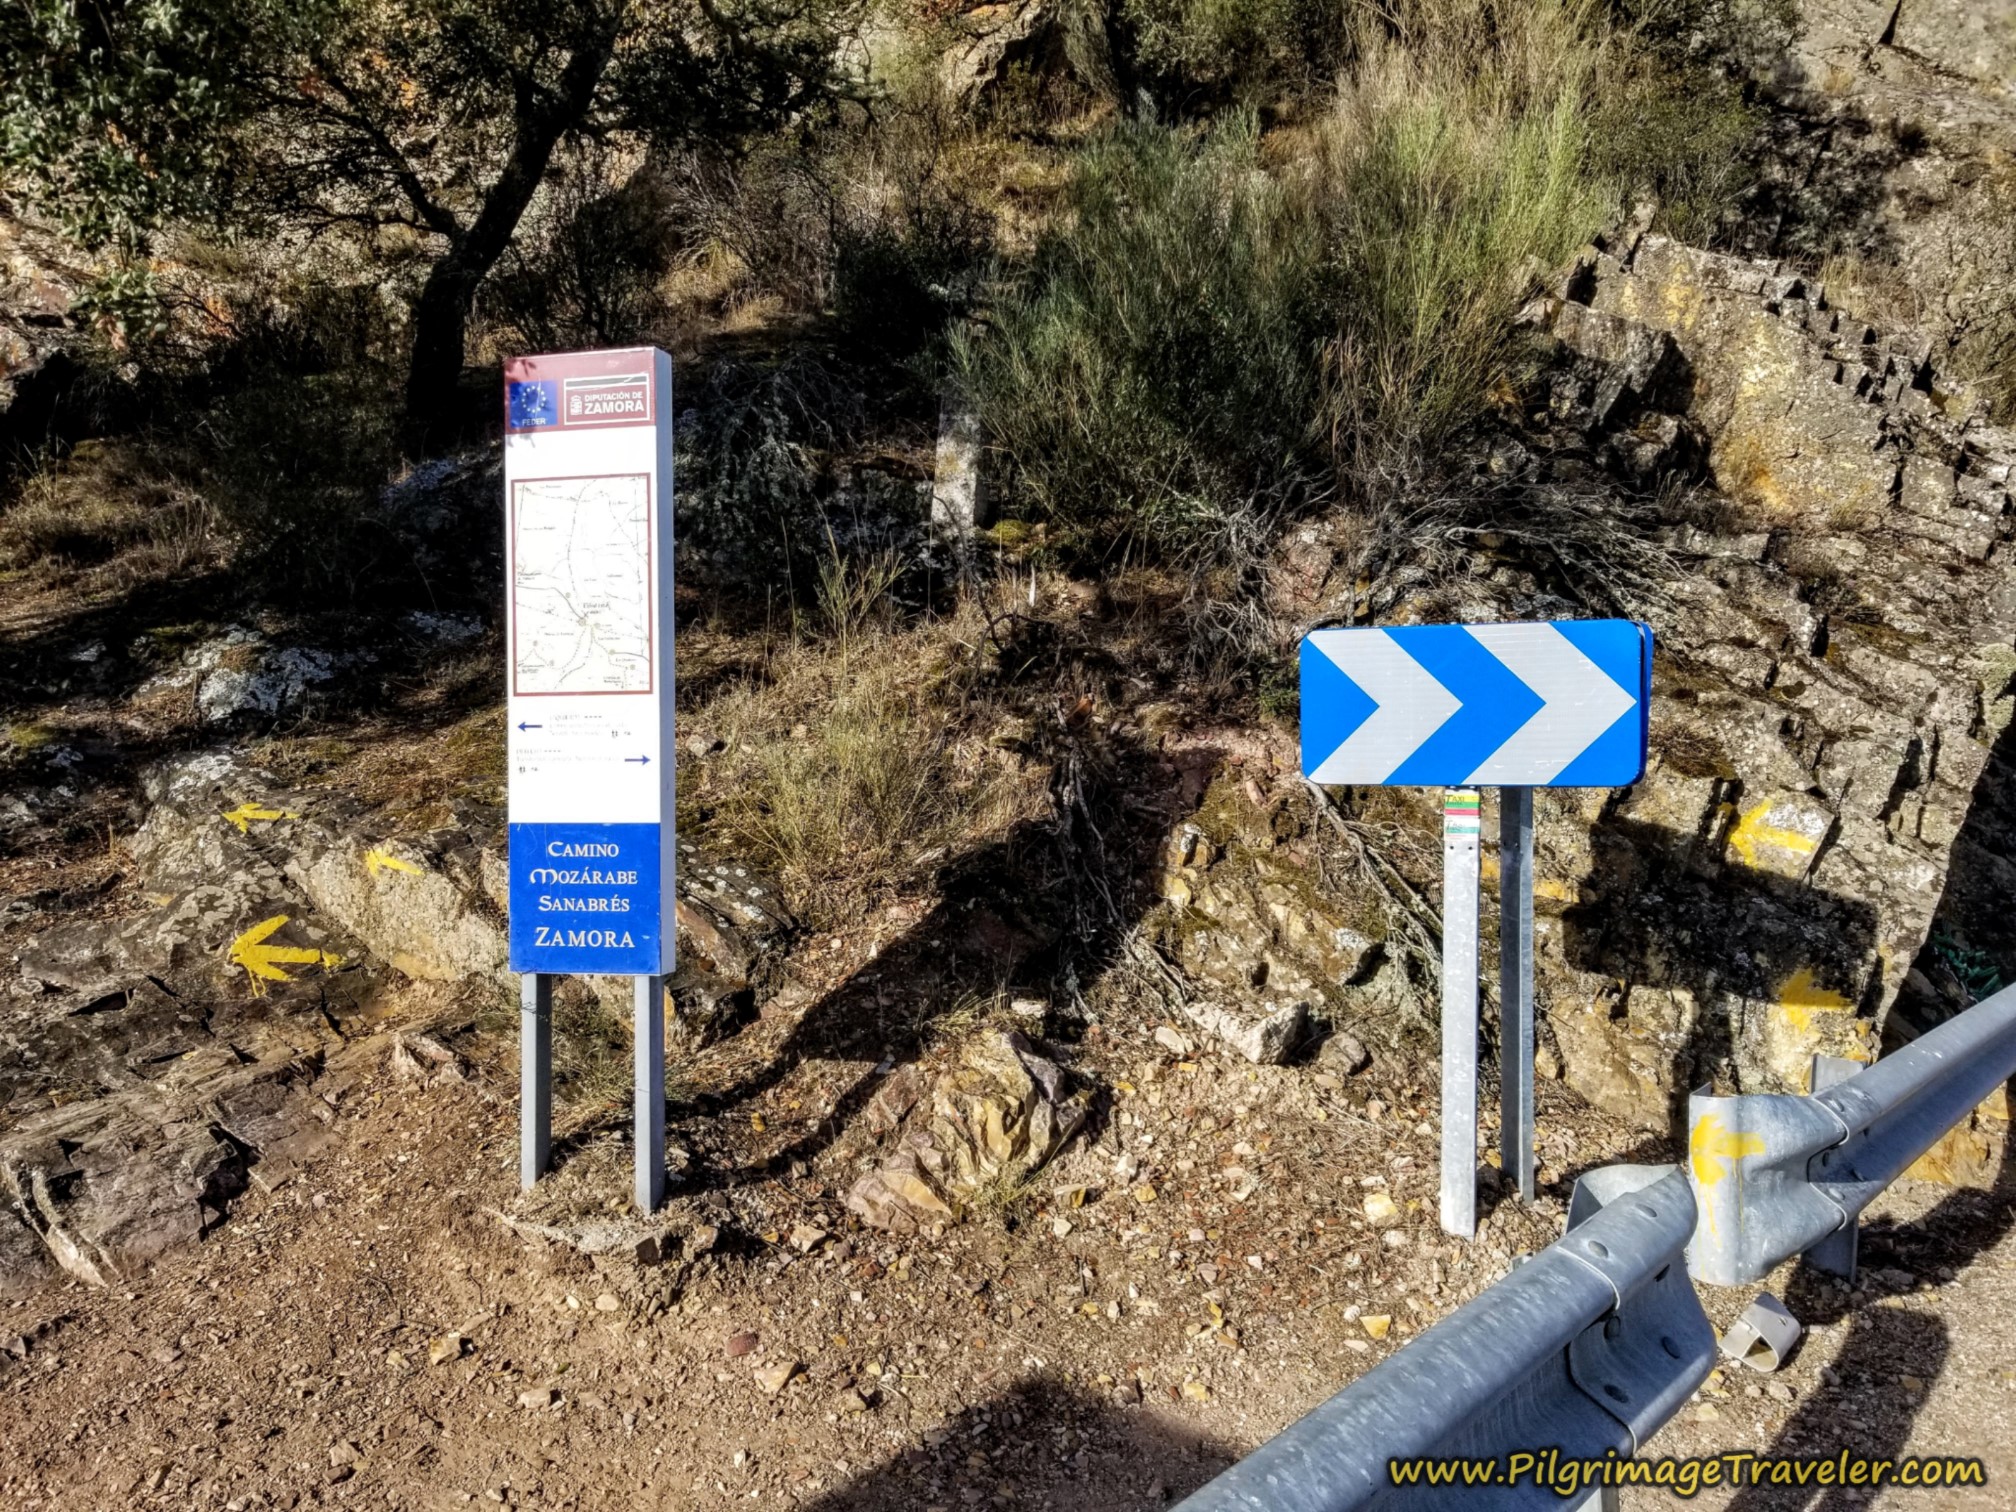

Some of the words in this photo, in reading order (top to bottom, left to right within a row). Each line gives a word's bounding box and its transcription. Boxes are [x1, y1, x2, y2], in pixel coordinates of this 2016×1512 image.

[584, 391, 630, 401] DIPUTACIÓN
[632, 391, 643, 399] DE
[584, 400, 645, 415] ZAMORA
[522, 417, 547, 426] FEDER
[547, 841, 620, 858] CAMINO
[529, 866, 638, 885] MOZÁRABE
[538, 894, 630, 912] SANABRÉS
[534, 926, 636, 948] ZAMORA
